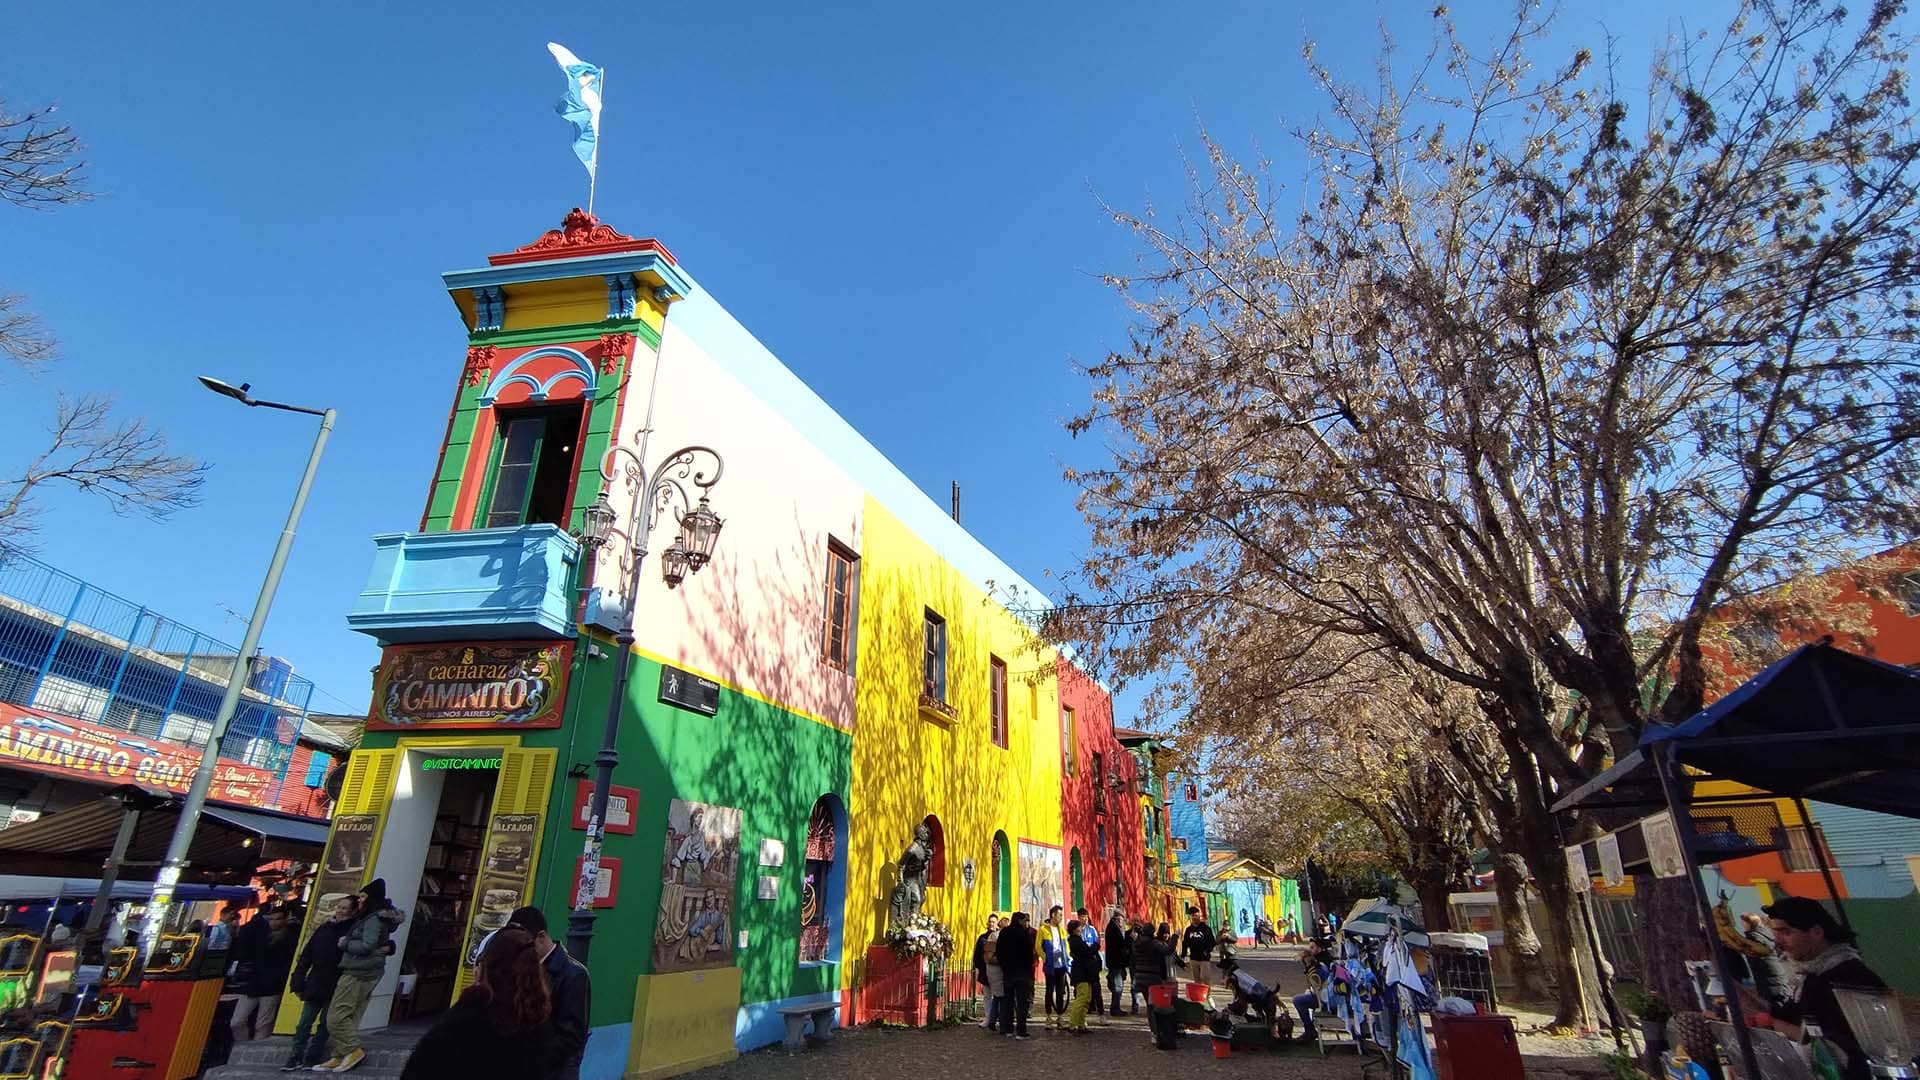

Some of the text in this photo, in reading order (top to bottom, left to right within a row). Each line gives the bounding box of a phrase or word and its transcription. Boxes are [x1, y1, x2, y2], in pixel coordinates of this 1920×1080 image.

[403, 678, 527, 711] CAMINITO
[426, 710, 491, 718] BUENOS AIRES
[78, 727, 117, 746] PASEO
[423, 758, 503, 771] @VISITCAMINITO
[337, 823, 373, 832] ALFAJOR
[496, 823, 533, 832] ALFAJOR
